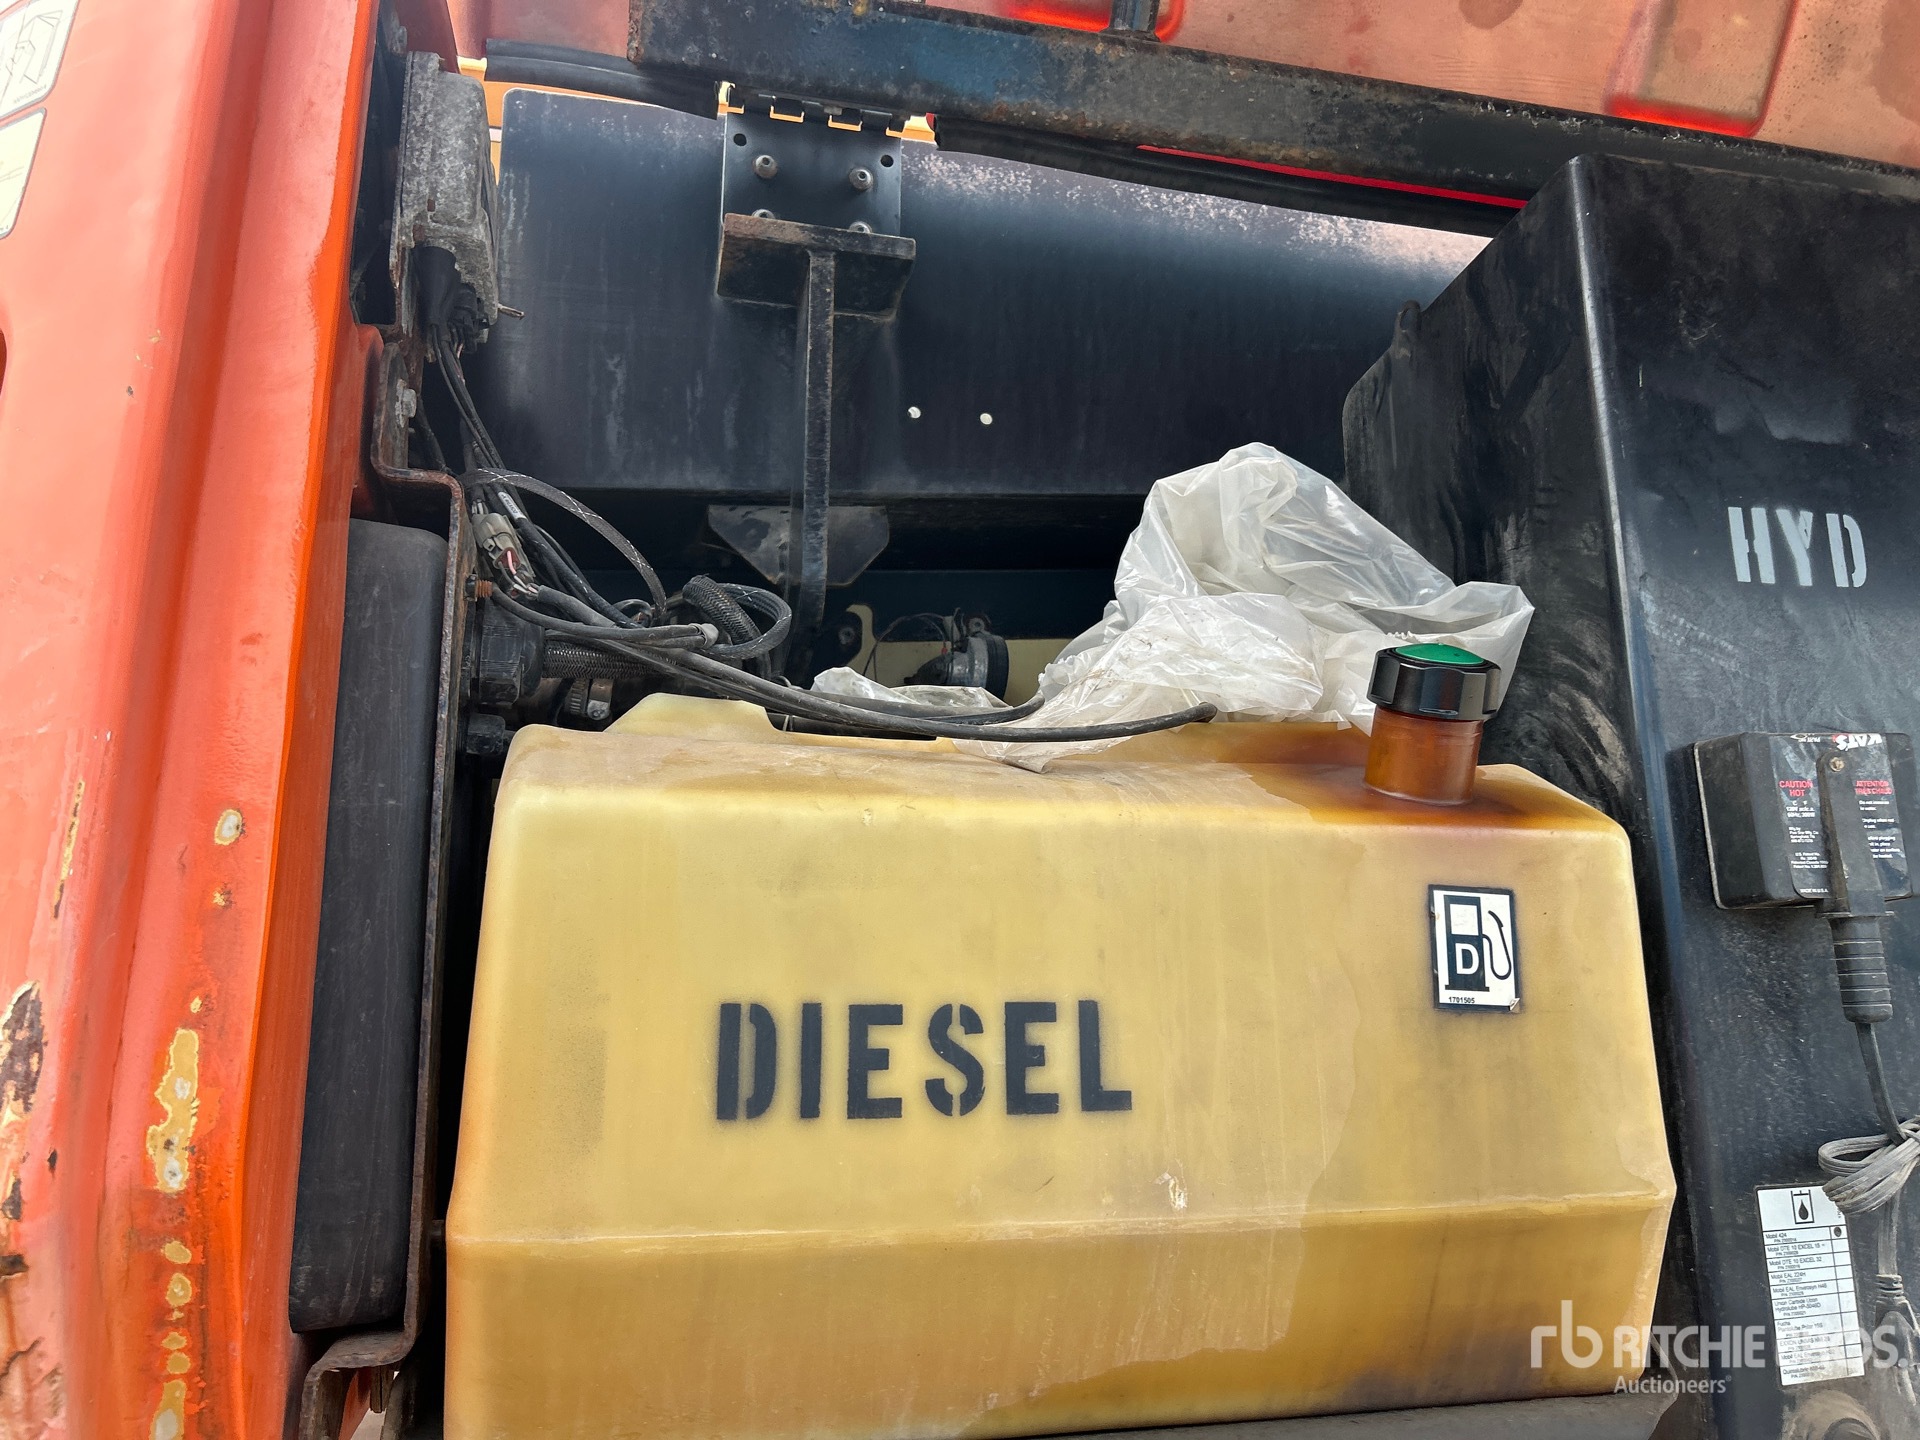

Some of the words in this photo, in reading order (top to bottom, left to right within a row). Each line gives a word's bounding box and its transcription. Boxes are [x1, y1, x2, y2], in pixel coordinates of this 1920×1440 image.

[1727, 506, 1867, 588] HYD
[1779, 780, 1813, 788] CAUTION
[1789, 789, 1805, 797] HOT
[1455, 943, 1480, 975] D
[1448, 996, 1476, 1004] 1701505
[716, 1000, 1133, 1120] DIESEL
